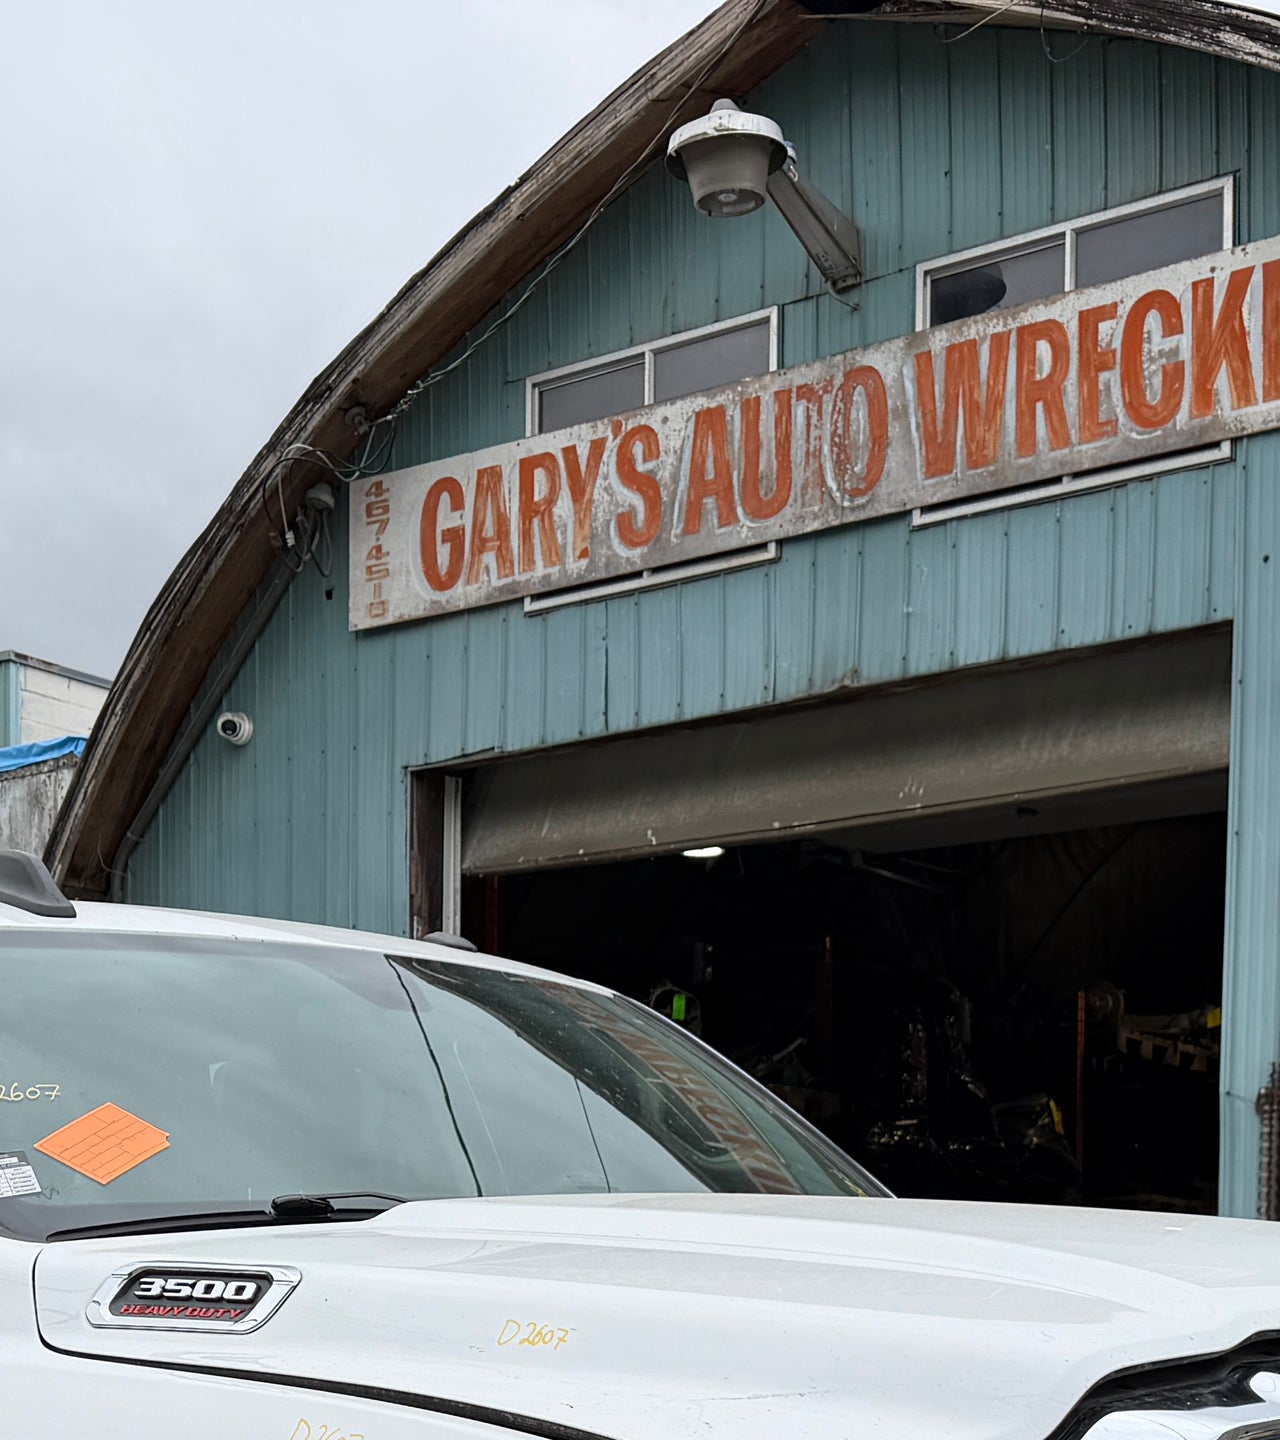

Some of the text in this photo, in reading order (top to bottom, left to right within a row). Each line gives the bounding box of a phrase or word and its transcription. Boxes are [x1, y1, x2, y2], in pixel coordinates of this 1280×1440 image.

[420, 419, 661, 592] GARY'S
[682, 365, 890, 536] AUTO
[132, 1277, 260, 1303] 3500
[120, 1304, 245, 1319] HEAVY DUTY
[496, 1319, 572, 1351] D2607
